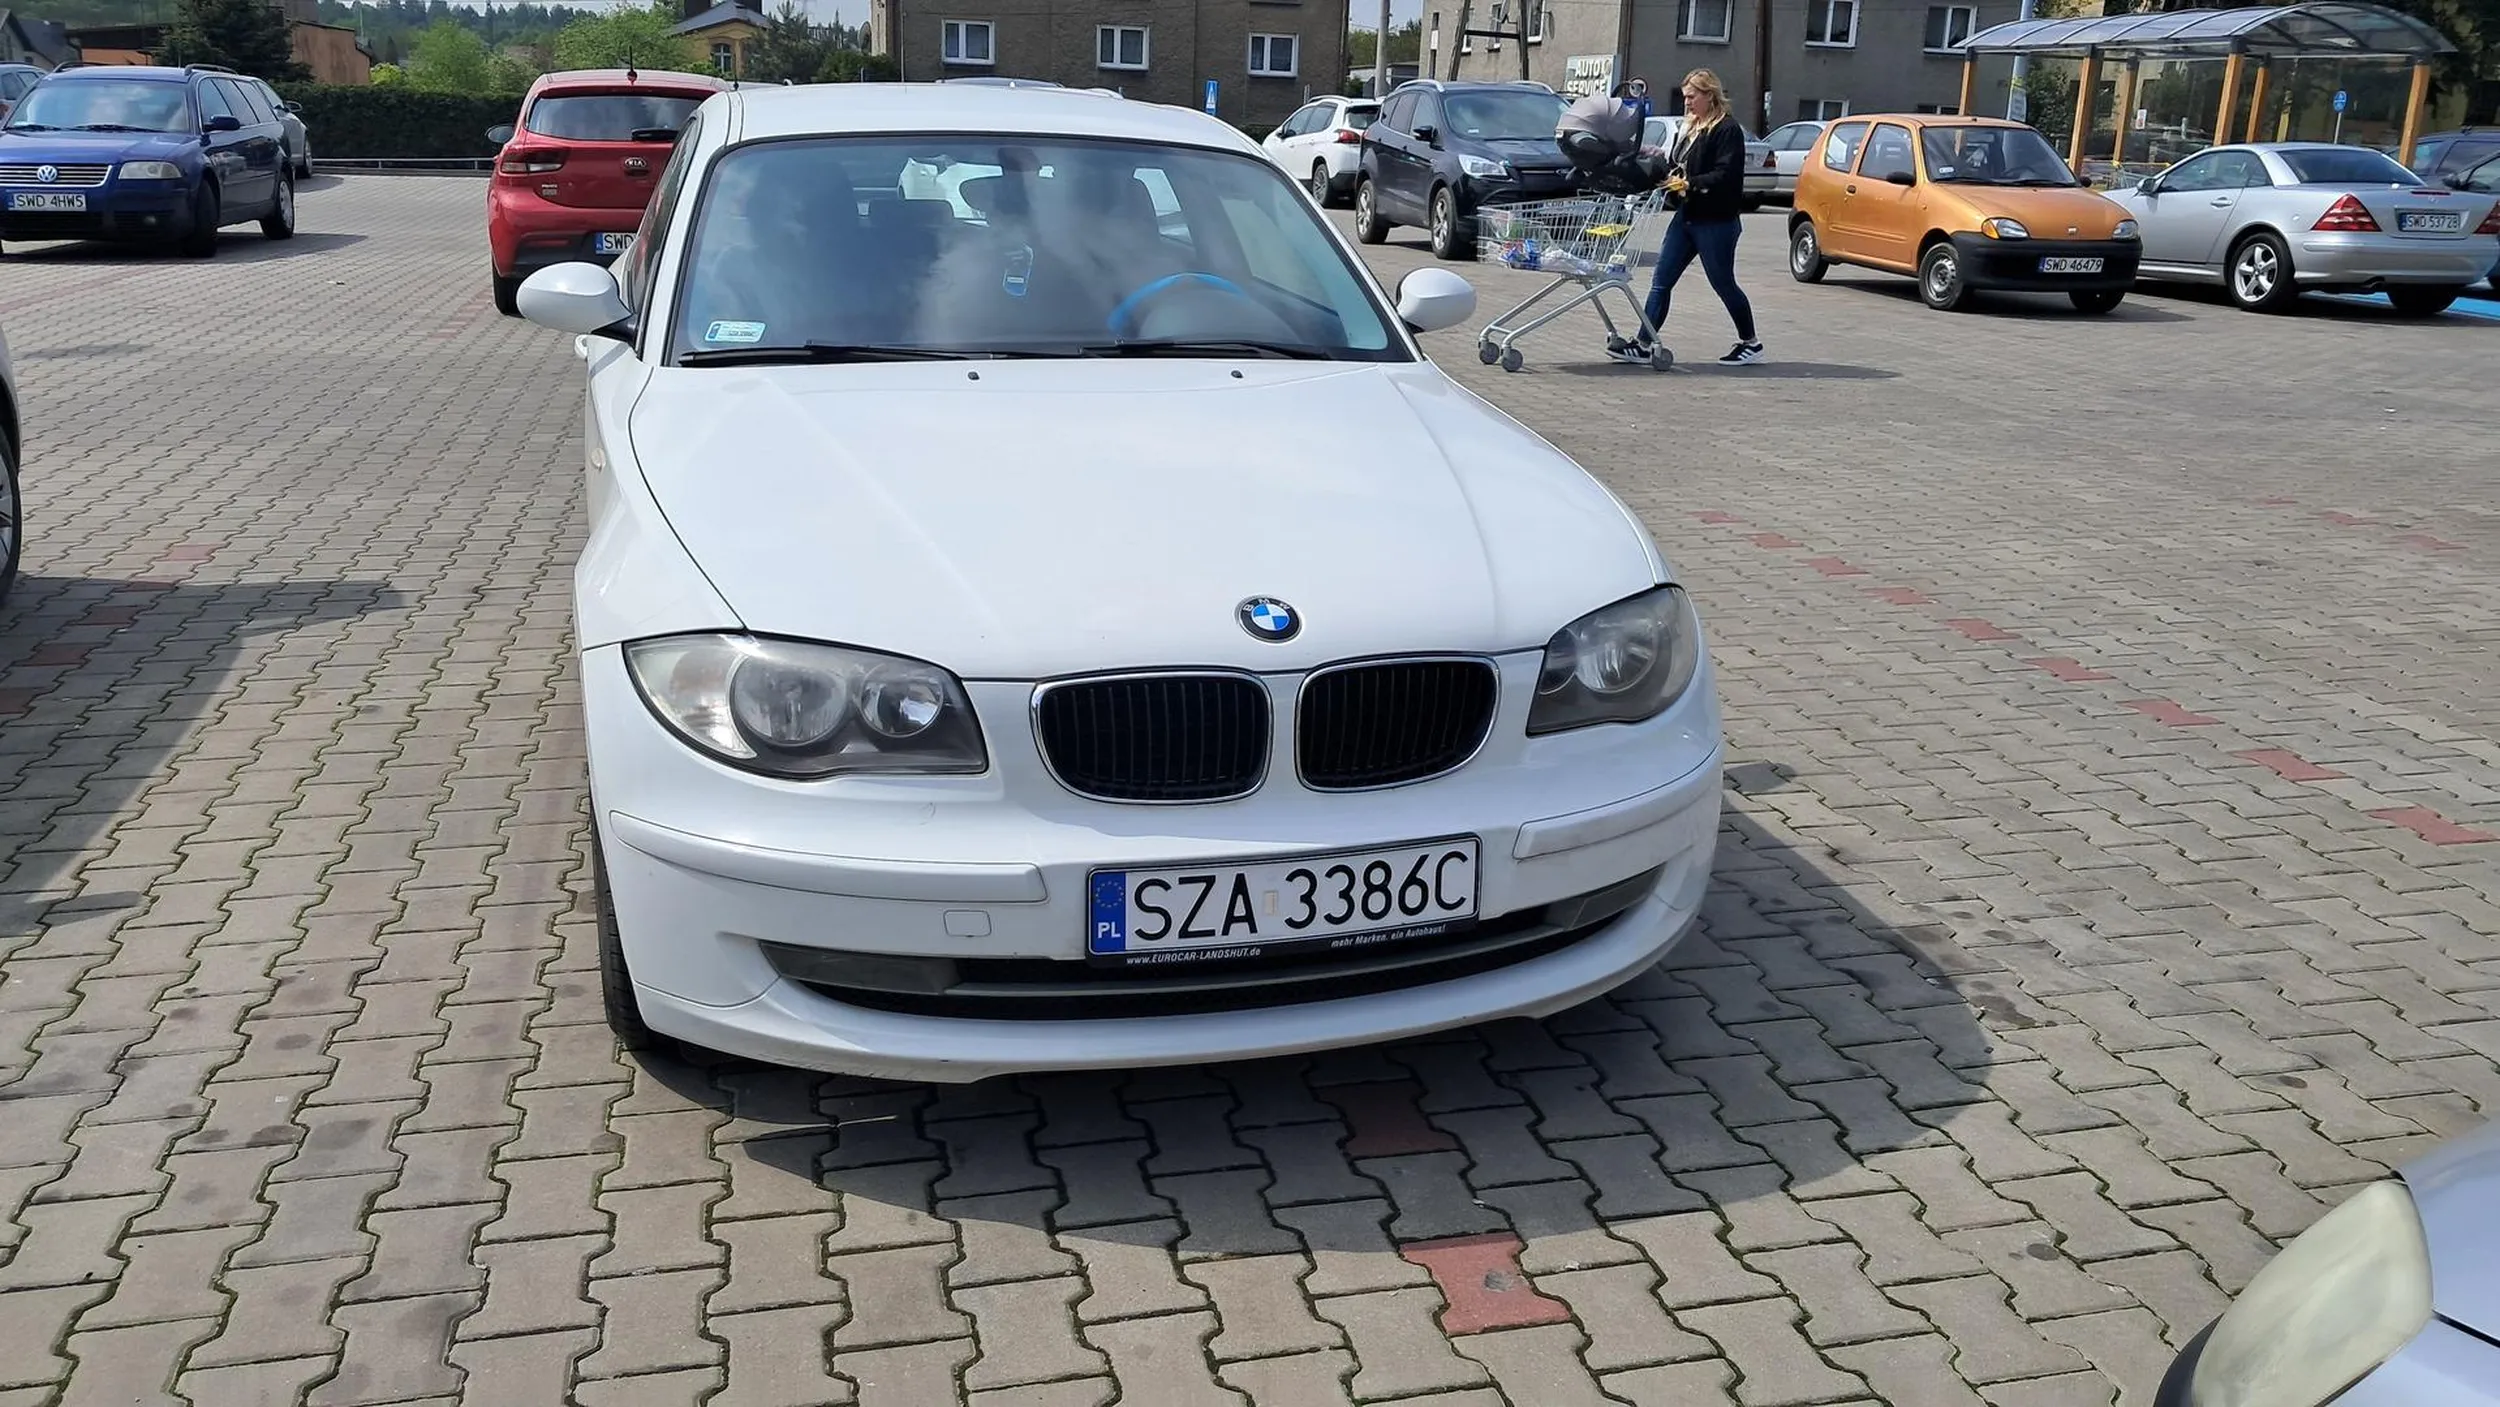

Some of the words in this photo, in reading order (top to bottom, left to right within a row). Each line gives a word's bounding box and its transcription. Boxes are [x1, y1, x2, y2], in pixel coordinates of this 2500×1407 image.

[1575, 58, 1601, 78] AUTO
[1567, 79, 1607, 96] SERVICE
[16, 194, 46, 208] SWD
[2407, 216, 2427, 228] SWD
[2044, 258, 2068, 271] SWD
[2069, 258, 2103, 272] 46479
[1243, 598, 1291, 612] BMW
[1133, 872, 1259, 942] SZA
[1284, 850, 1469, 930] 3386C
[1097, 921, 1122, 939] PL
[1330, 936, 1354, 948] mehr
[1390, 929, 1405, 941] ein
[1126, 946, 1262, 965] www.EUROCAR-LANDSHUT.de
